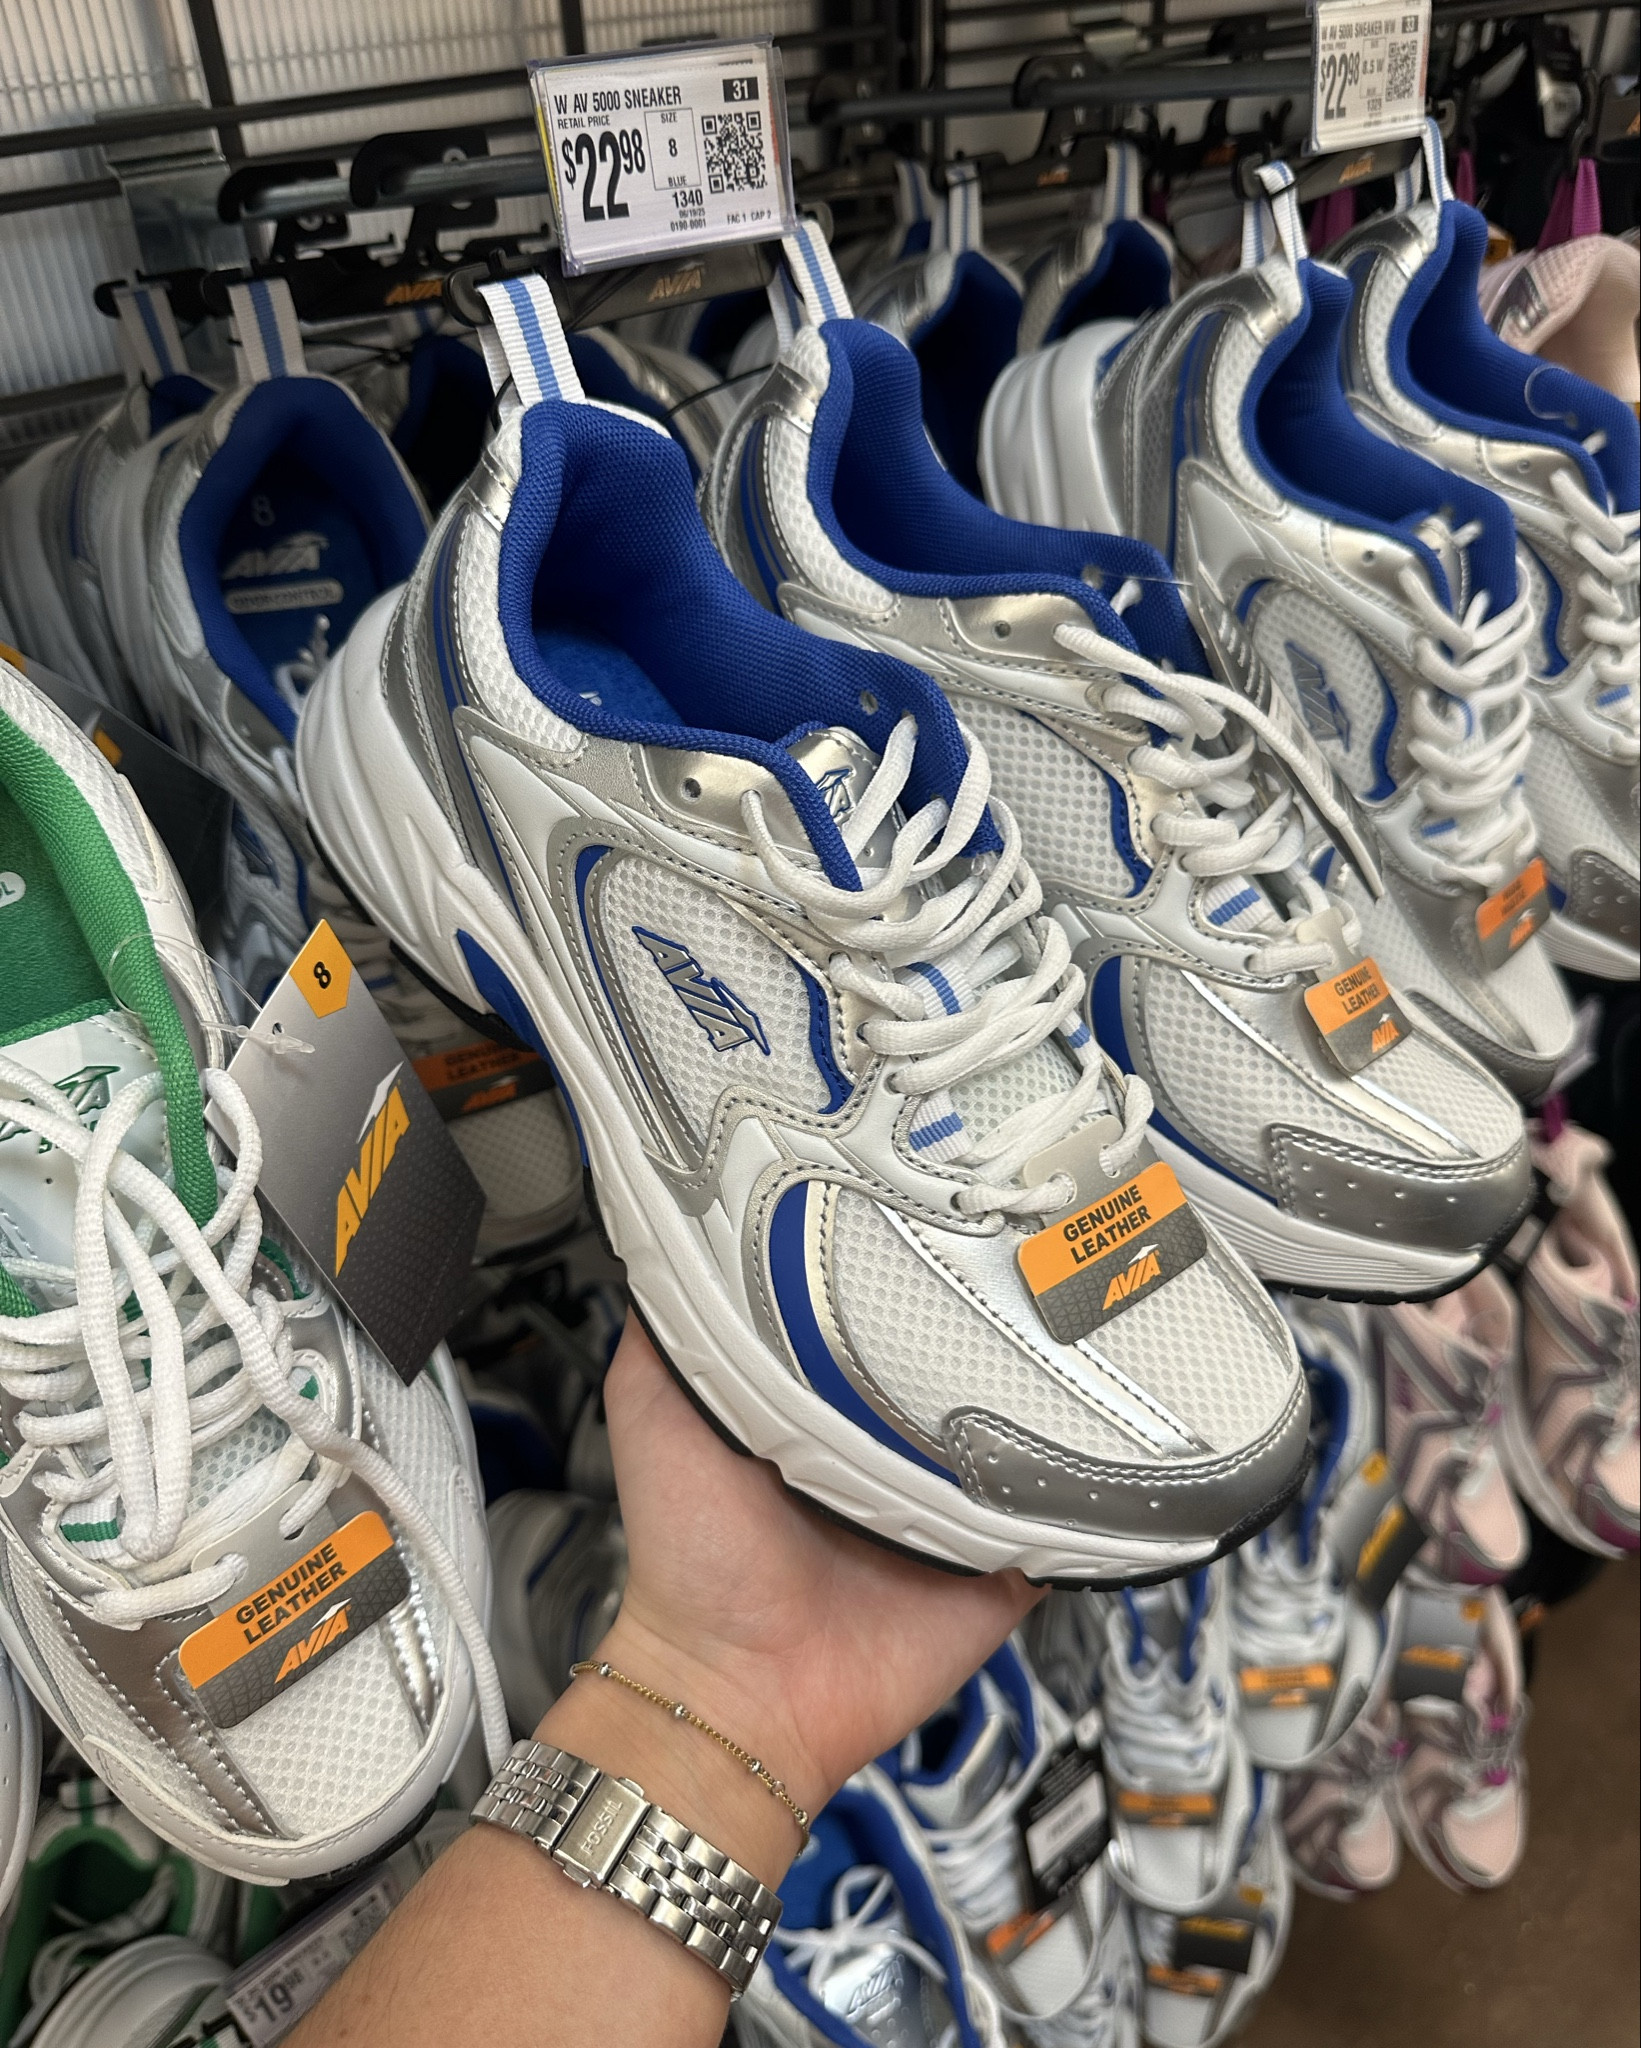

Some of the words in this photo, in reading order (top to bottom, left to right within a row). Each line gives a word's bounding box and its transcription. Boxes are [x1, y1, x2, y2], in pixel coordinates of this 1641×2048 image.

[1354, 20, 1382, 38] SNEAKER
[554, 94, 568, 115] W
[573, 92, 588, 113] AV
[593, 90, 621, 112] 5000
[625, 86, 682, 109] SNEAKER
[732, 80, 750, 100] 31
[558, 117, 586, 129] RETAIL
[587, 115, 611, 127] PRICE
[660, 112, 678, 123] SIZE
[668, 138, 678, 158] 8
[668, 176, 688, 187] BLUE
[672, 189, 704, 208] 1340
[313, 961, 332, 989] 8
[631, 926, 770, 1056] AVIA
[1334, 966, 1372, 997] GENUINE
[1341, 983, 1381, 1015] LEATHER
[1372, 1018, 1400, 1053] AVIA
[335, 1084, 411, 1278] AVIA
[1063, 1184, 1142, 1242] GENUINE
[1071, 1205, 1151, 1264] LEATHER
[1102, 1249, 1161, 1311] AVIA
[236, 1543, 338, 1624] GENUINE
[243, 1561, 347, 1644] LEATHER
[274, 1606, 349, 1684] AVIA
[581, 1800, 623, 1856] FOSSIL
